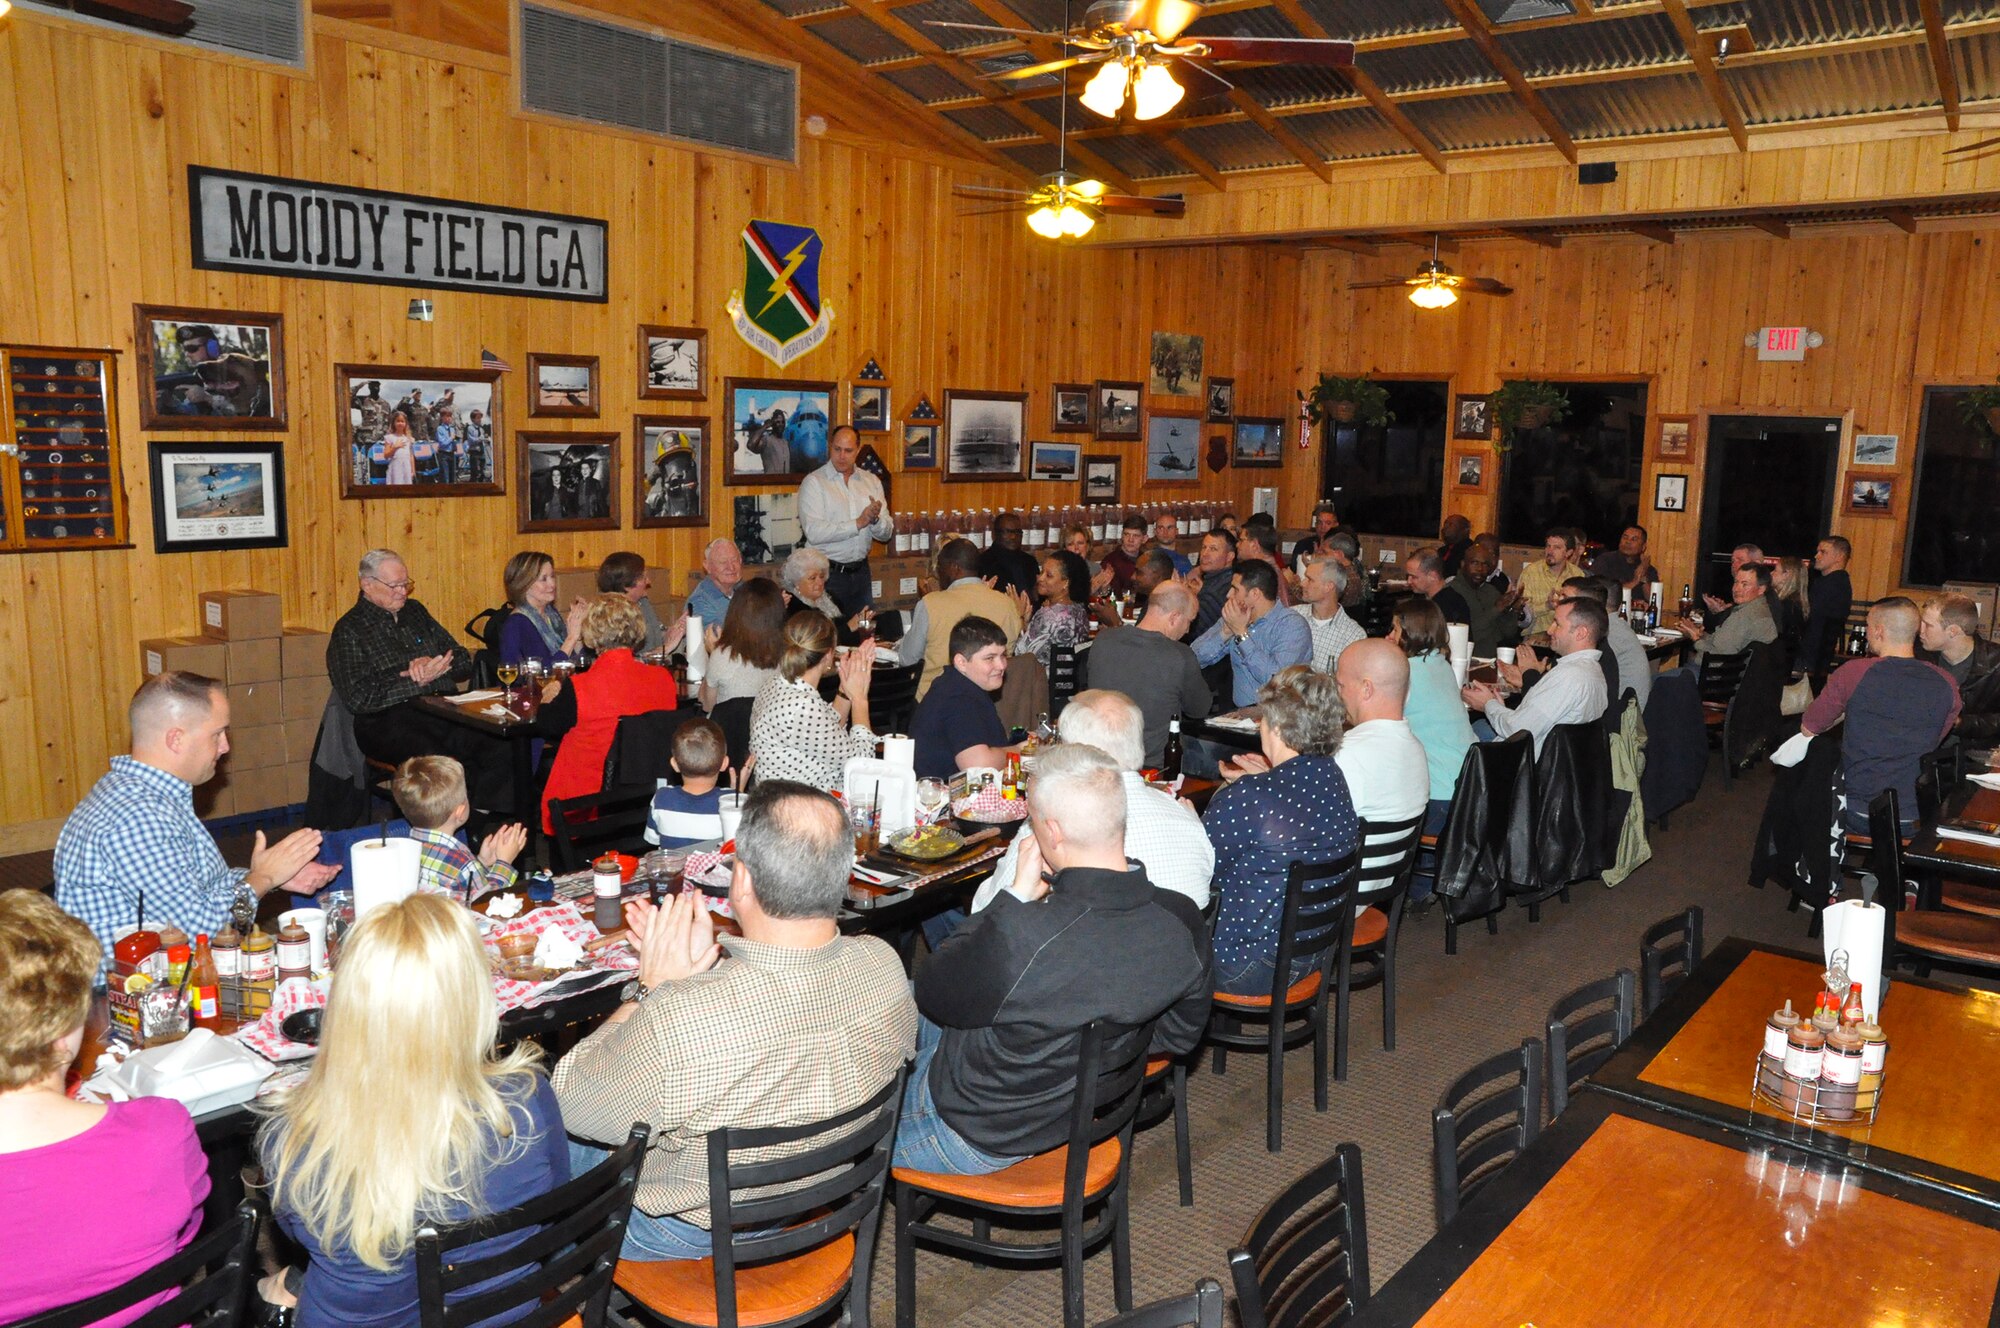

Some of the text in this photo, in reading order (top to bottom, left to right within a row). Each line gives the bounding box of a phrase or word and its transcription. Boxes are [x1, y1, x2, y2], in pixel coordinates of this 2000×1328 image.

[226, 185, 588, 290] MOODY FIELD GA
[1768, 329, 1799, 350] EXIT
